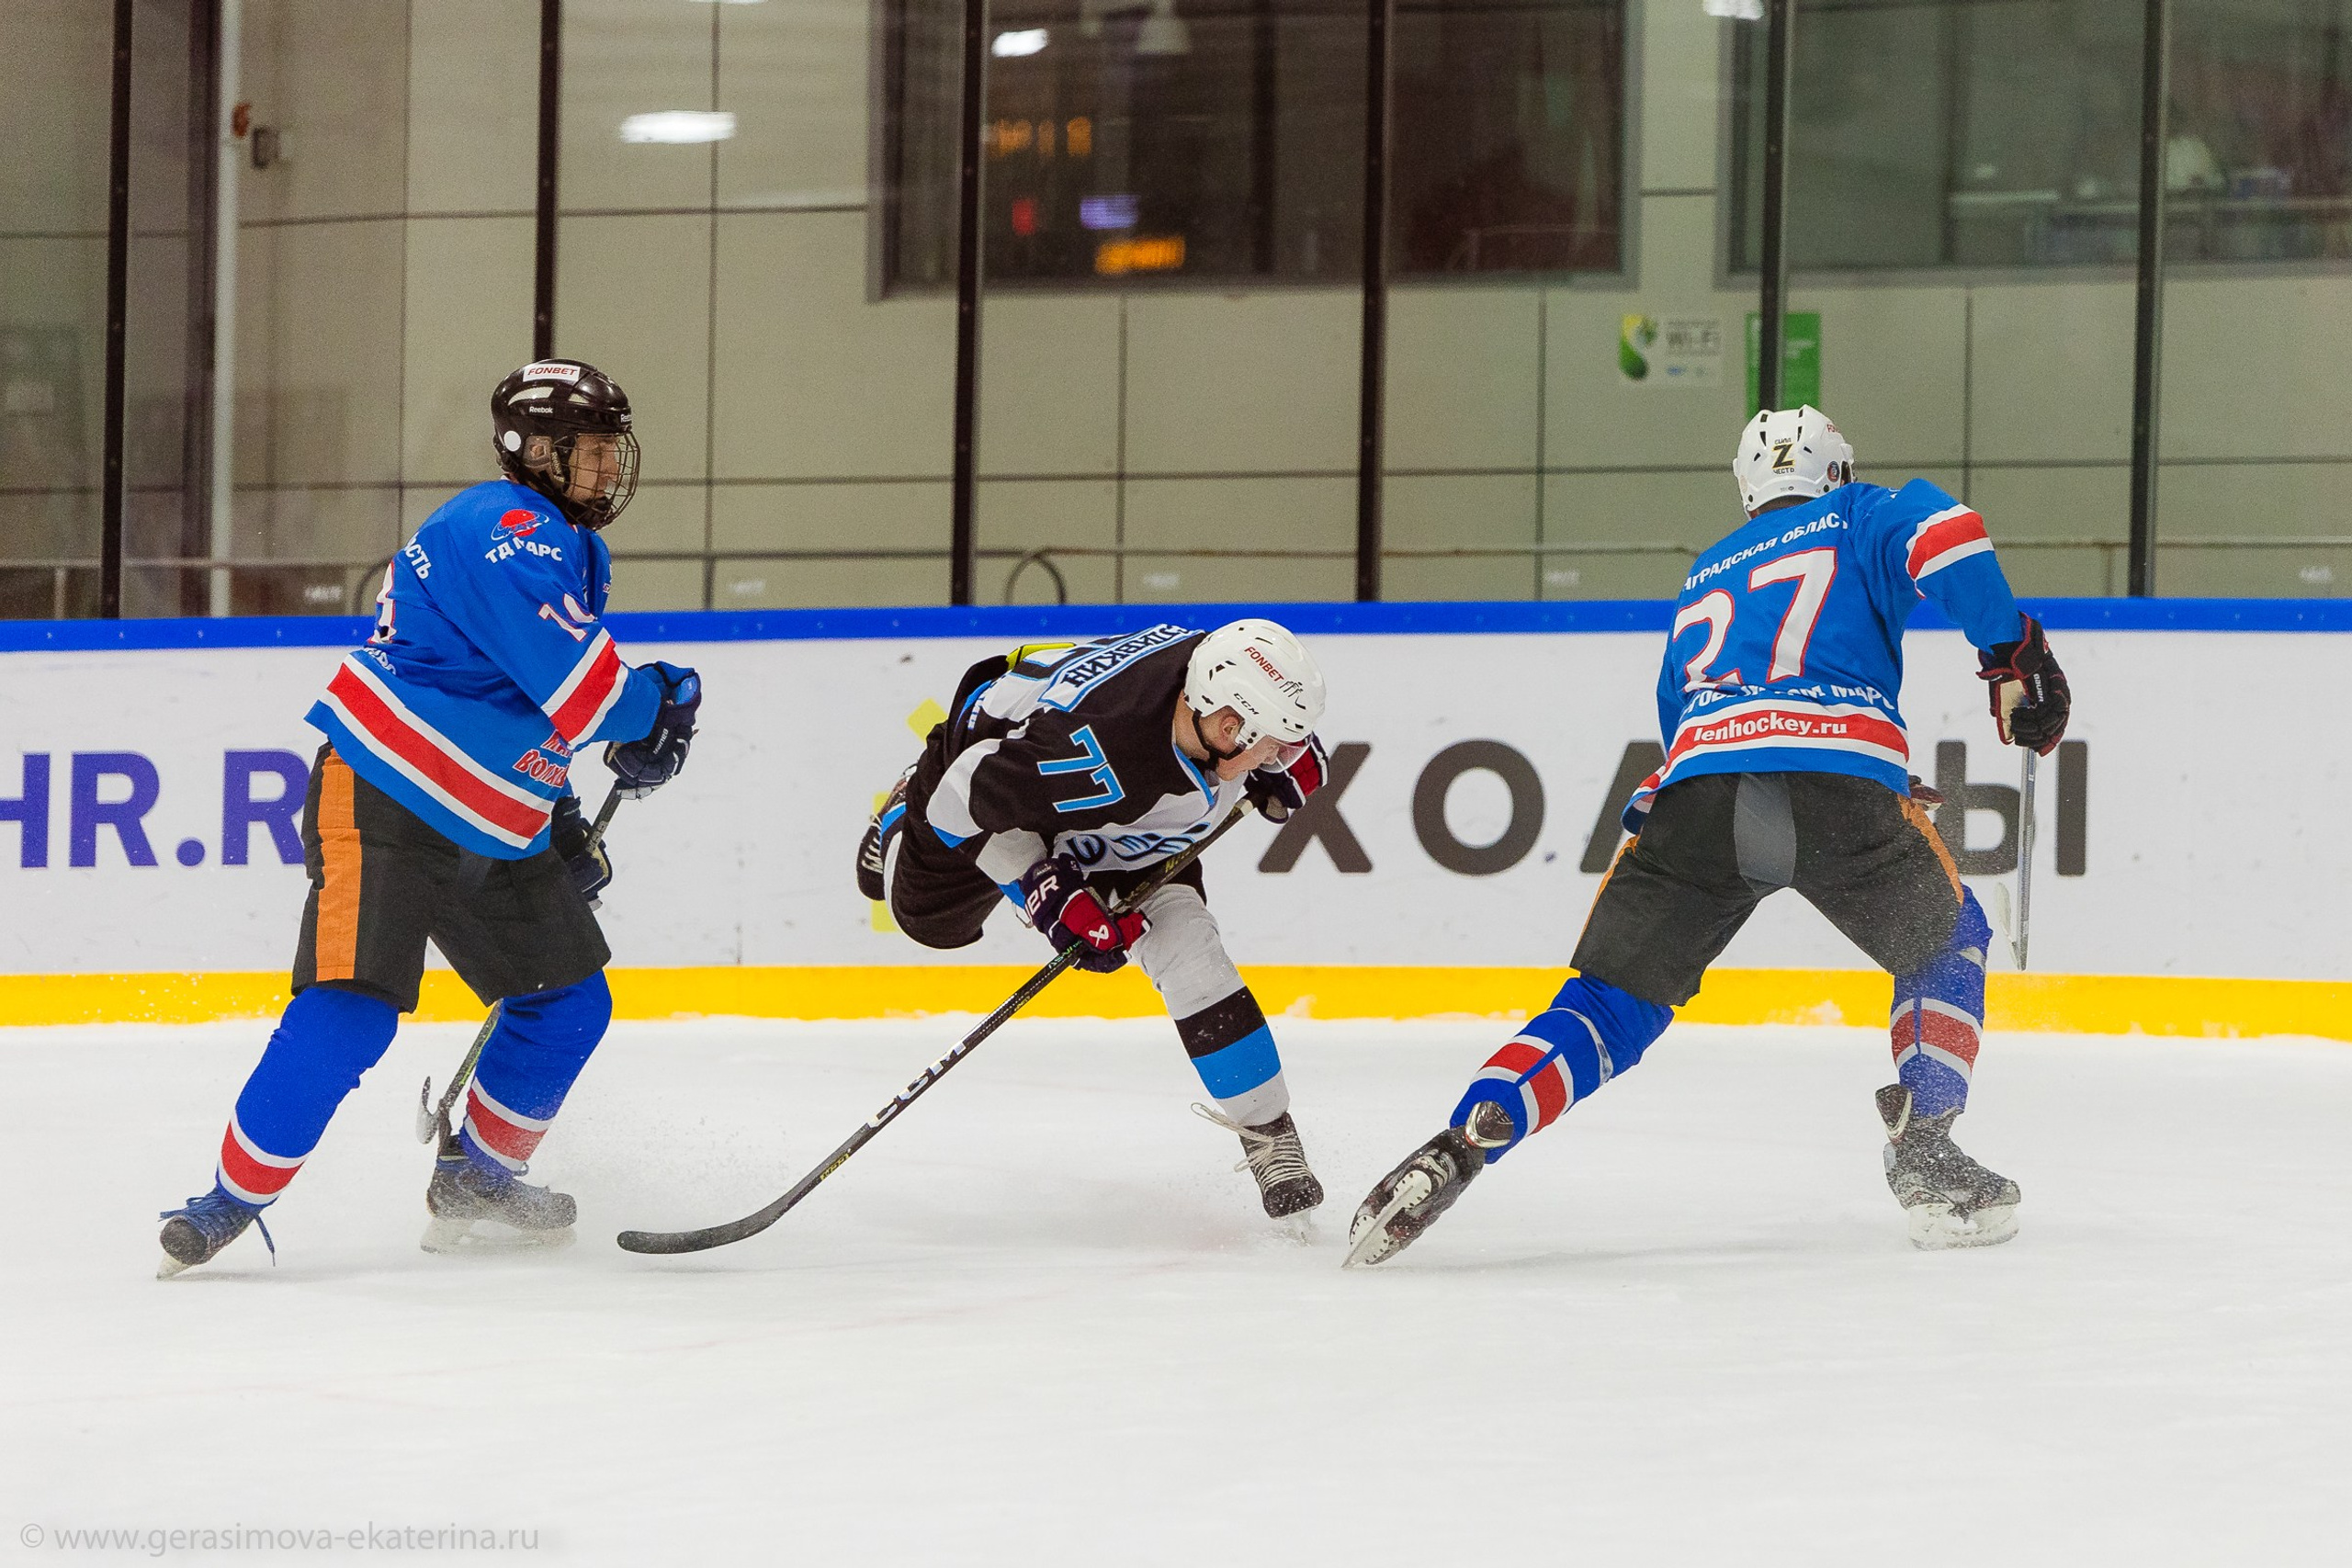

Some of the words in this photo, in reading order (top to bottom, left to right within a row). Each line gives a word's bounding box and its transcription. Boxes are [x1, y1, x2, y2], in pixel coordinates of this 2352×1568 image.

[527, 367, 578, 376] FONBET
[1772, 443, 1795, 469] Z
[485, 541, 515, 564] ТД
[1672, 546, 1837, 694] 27
[1244, 646, 1284, 682] FONBET
[1233, 693, 1260, 715] CCM
[1693, 712, 1848, 742] lenhockey.ru
[1037, 723, 1125, 814] 77
[867, 1041, 967, 1130] CCM
